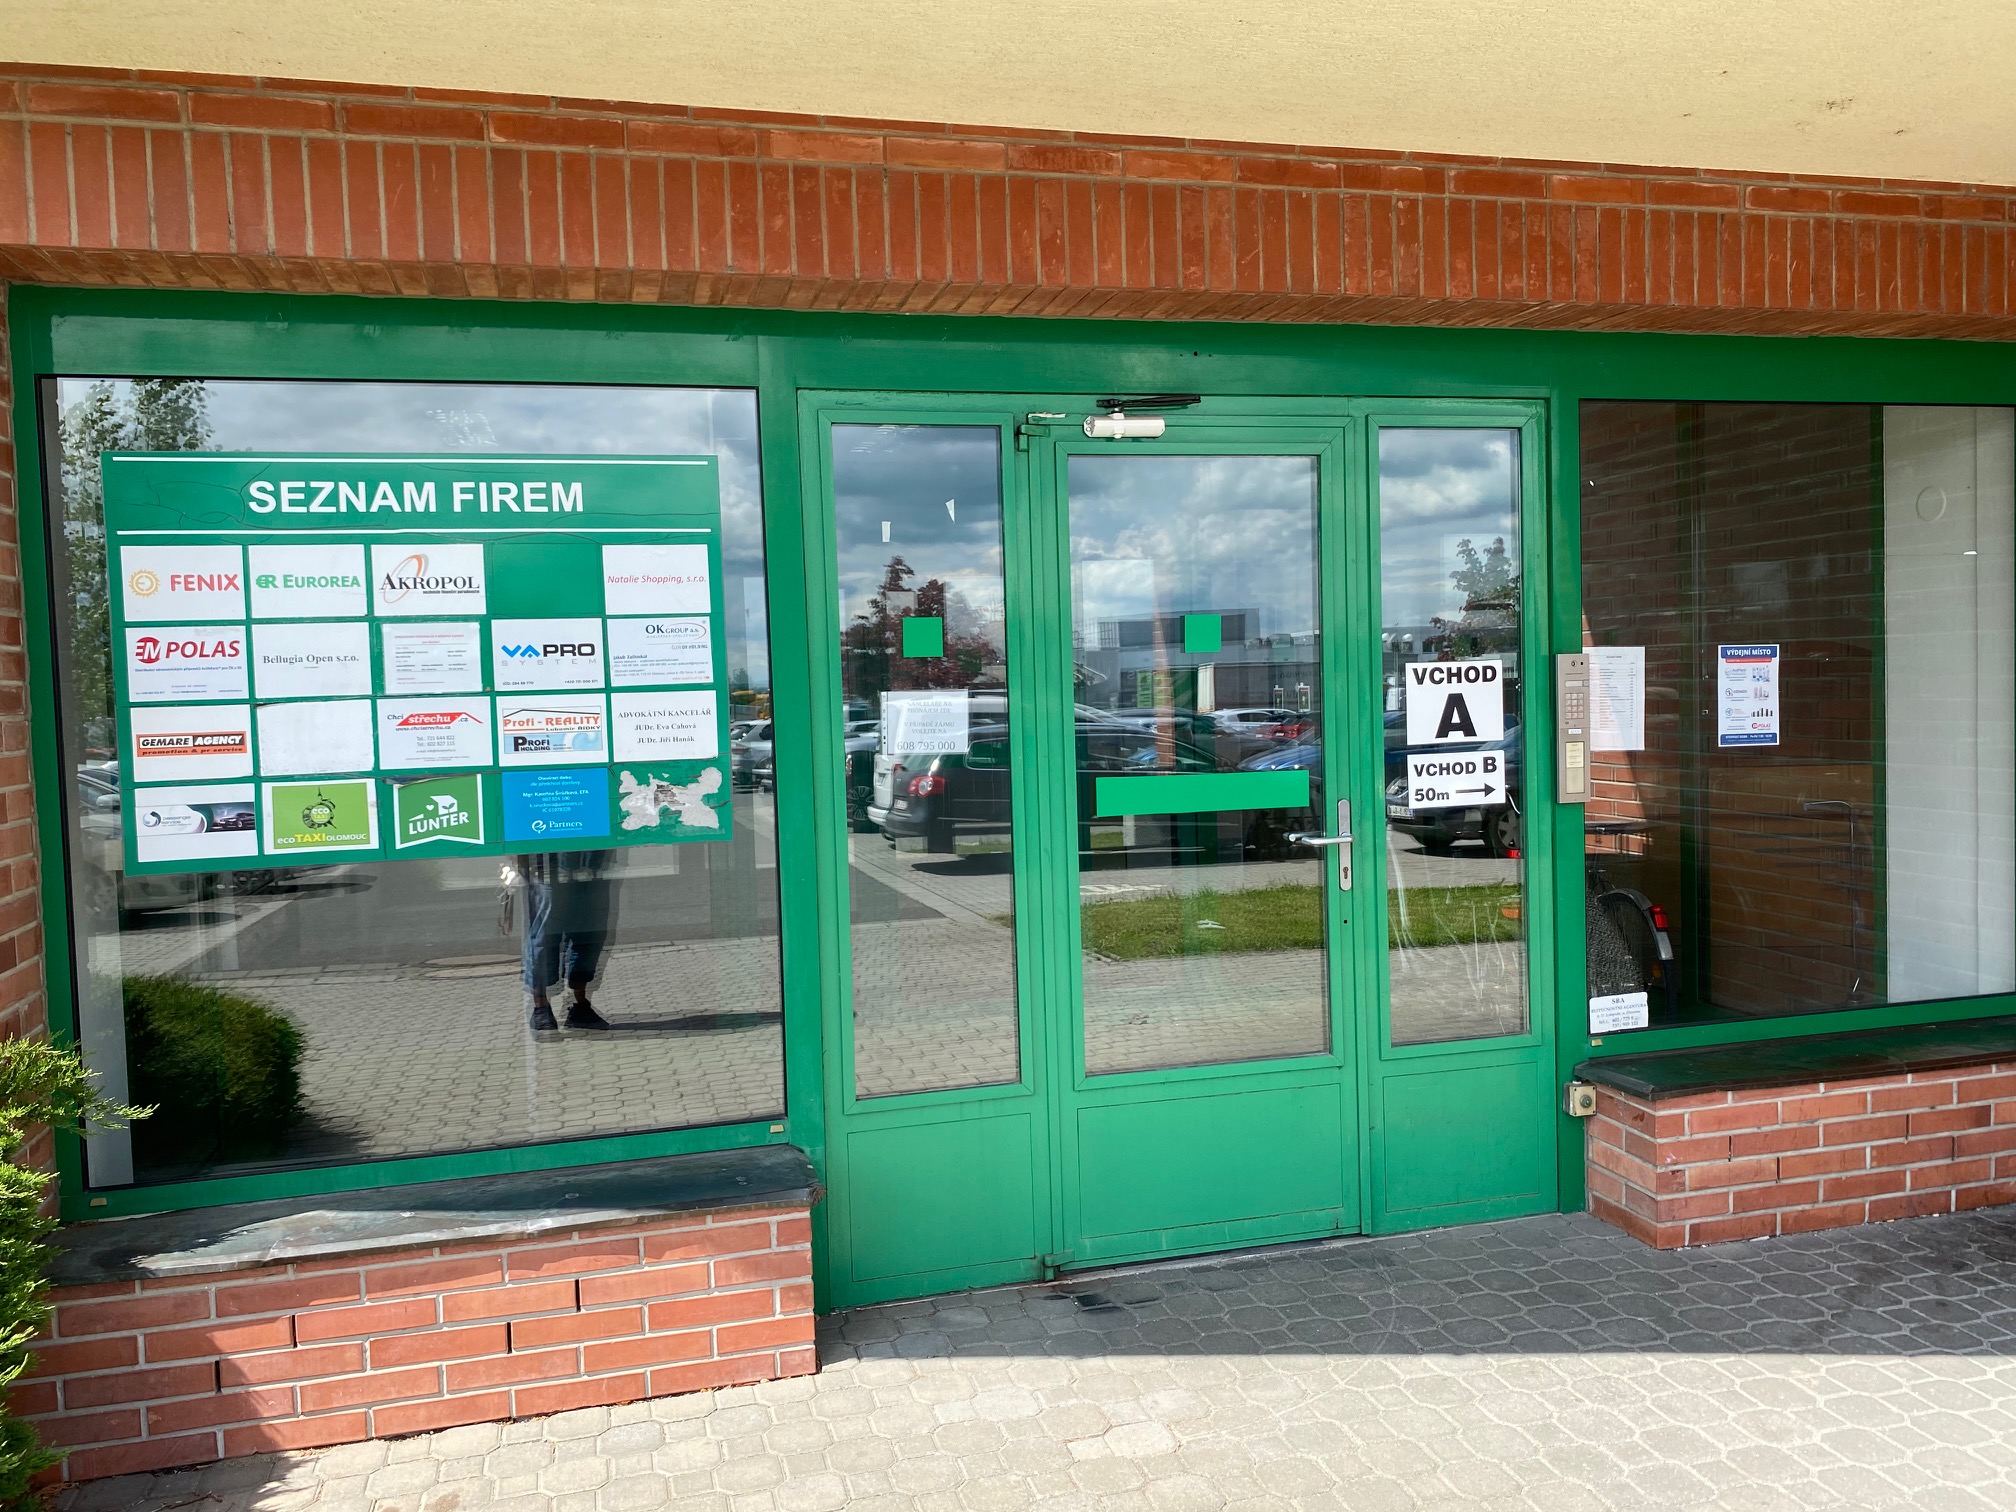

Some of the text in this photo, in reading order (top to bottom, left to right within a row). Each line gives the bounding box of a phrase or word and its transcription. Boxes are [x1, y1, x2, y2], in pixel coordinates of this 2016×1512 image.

[248, 480, 584, 514] SEZNAM FIREM
[170, 573, 240, 592] FENIX
[283, 574, 361, 588] EUROREA
[379, 573, 480, 590] AKROPOL
[607, 574, 707, 584] Natalie Shopping, s.r.o.
[645, 624, 665, 634] OK
[165, 640, 240, 658] POLAS
[1726, 647, 1771, 657] VÝDEJNÍ MÍSTO
[263, 654, 304, 665] Bellugia
[306, 654, 334, 664] Open
[1412, 665, 1497, 685] VCHOD
[408, 713, 451, 724] střechu
[618, 707, 712, 718] ADVOKÁTNÍ KANCELÁŘ
[1435, 692, 1478, 739] A
[503, 718, 534, 727] Profi
[545, 716, 600, 726] REALITY
[142, 735, 242, 747] GEMARE AGENCY
[896, 741, 956, 750] 608 795 000
[1413, 756, 1498, 778] VCHOD B
[1414, 787, 1450, 802] 50m
[549, 820, 583, 828] Partners
